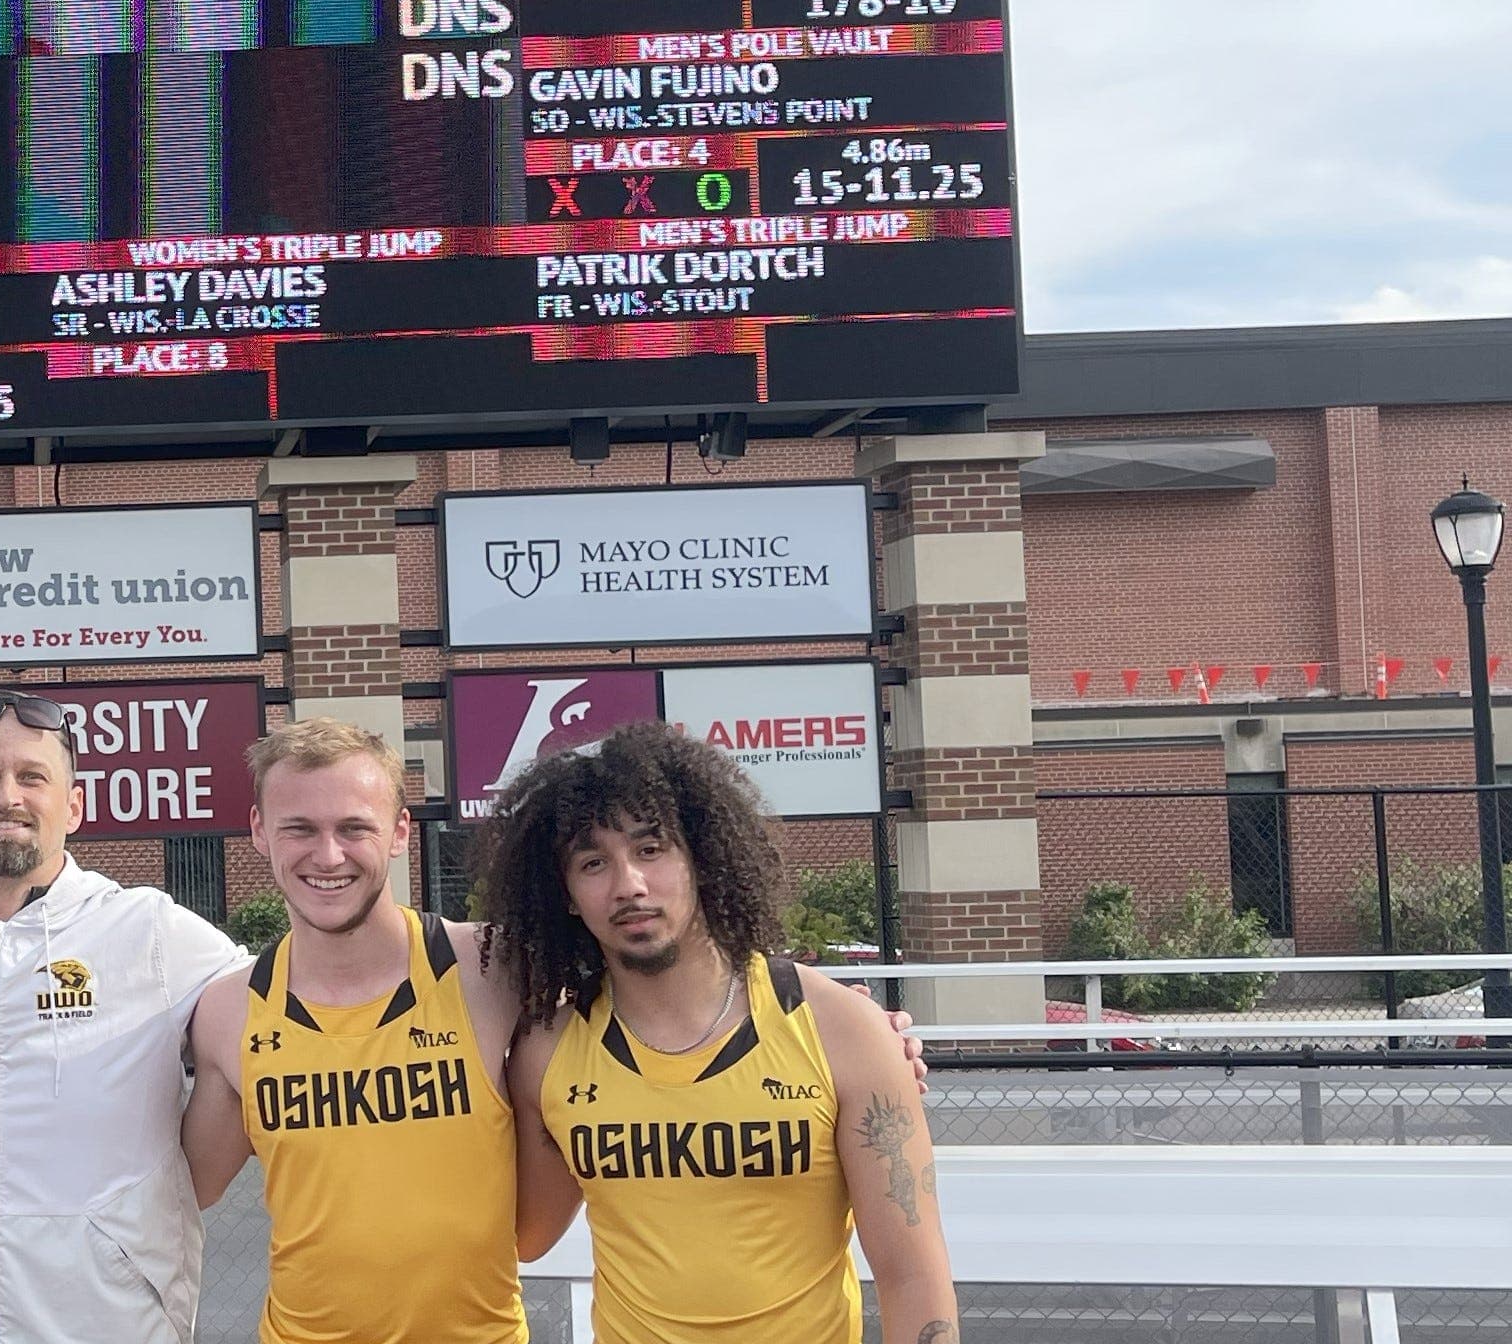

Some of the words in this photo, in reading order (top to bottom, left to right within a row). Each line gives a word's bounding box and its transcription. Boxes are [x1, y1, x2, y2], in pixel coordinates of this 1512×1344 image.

[638, 34, 726, 61] MEN'S
[732, 31, 804, 58] POLE
[812, 29, 894, 54] VAULT
[402, 48, 514, 100] DNS
[529, 66, 641, 102] GAVIN
[650, 63, 779, 97] FUJINO
[531, 108, 568, 133] SO
[786, 96, 873, 124] POINT
[572, 142, 680, 170] PLACE:
[688, 139, 711, 164] 4
[842, 139, 931, 164] 4.86m
[793, 164, 983, 205] 15-11.25
[639, 220, 726, 246] MEN'S
[732, 217, 828, 242] TRIPLE
[834, 214, 910, 238] JUMP
[128, 238, 262, 266] WOMEN'S
[267, 234, 361, 261] TRIPLE
[367, 230, 442, 257] JUMP
[537, 253, 665, 288] PATRIK
[675, 247, 825, 282] DORTCH
[52, 271, 191, 306] ASHLEY
[199, 265, 328, 299] DAVIES
[107, 307, 211, 334] WIS.-LA
[216, 303, 320, 330] CROSSE
[538, 294, 572, 318] FR
[92, 344, 198, 373] PLACE:
[580, 539, 670, 563] MAYO
[679, 536, 789, 560] CLINIC
[111, 569, 248, 603] union
[580, 568, 702, 593] HEALTH
[712, 565, 829, 589] SYSTEM
[33, 629, 74, 646] For
[79, 627, 150, 649] Every
[156, 625, 208, 643] You.
[776, 748, 862, 762] Professionals
[37, 991, 92, 1010] UWO
[410, 1030, 458, 1048] WIAC
[256, 1058, 471, 1131] OSHKOSH
[765, 1084, 822, 1100] WIAC
[570, 1119, 811, 1180] OSHKOSH
